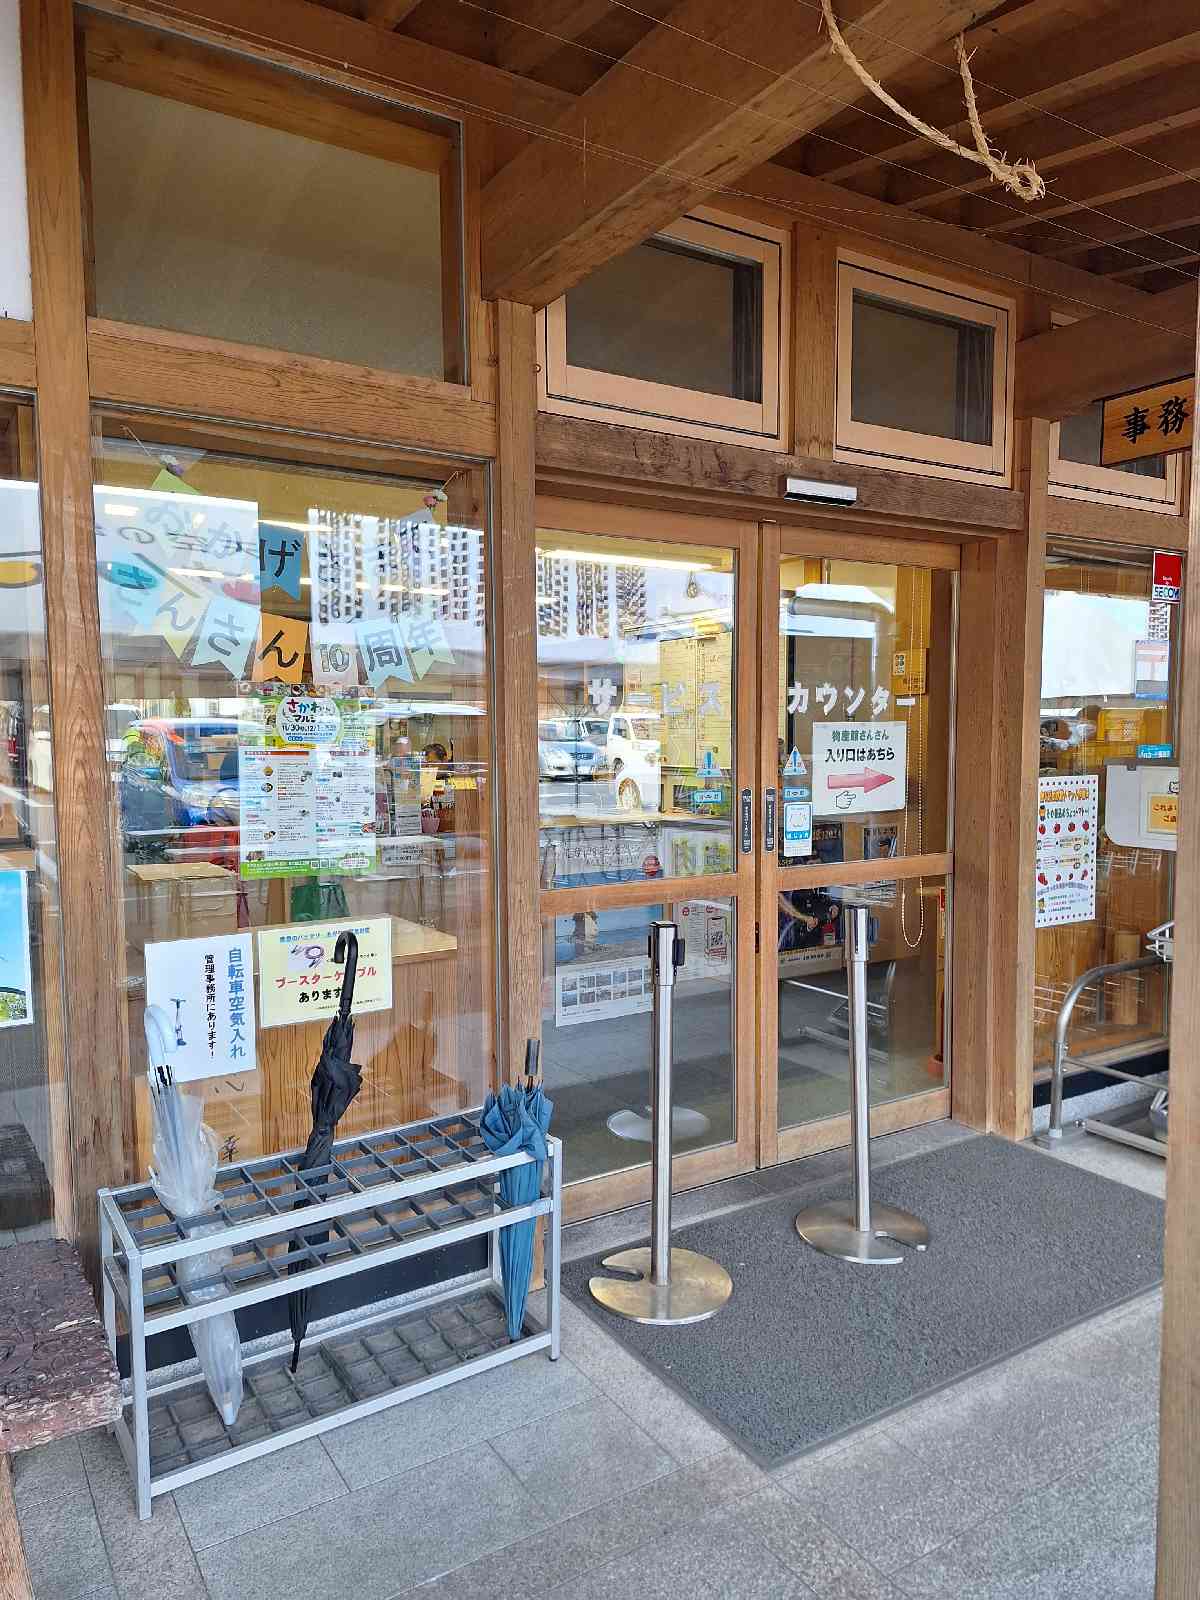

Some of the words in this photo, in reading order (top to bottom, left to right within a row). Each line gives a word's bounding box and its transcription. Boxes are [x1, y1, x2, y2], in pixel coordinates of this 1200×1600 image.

[1154, 587, 1180, 599] SECOM
[787, 681, 916, 717] カウンター
[825, 747, 895, 762] 入り口はあちら
[275, 967, 377, 988] ブースターケブル
[228, 947, 246, 1060] 自転車空気入れ
[299, 986, 342, 1003] あります
